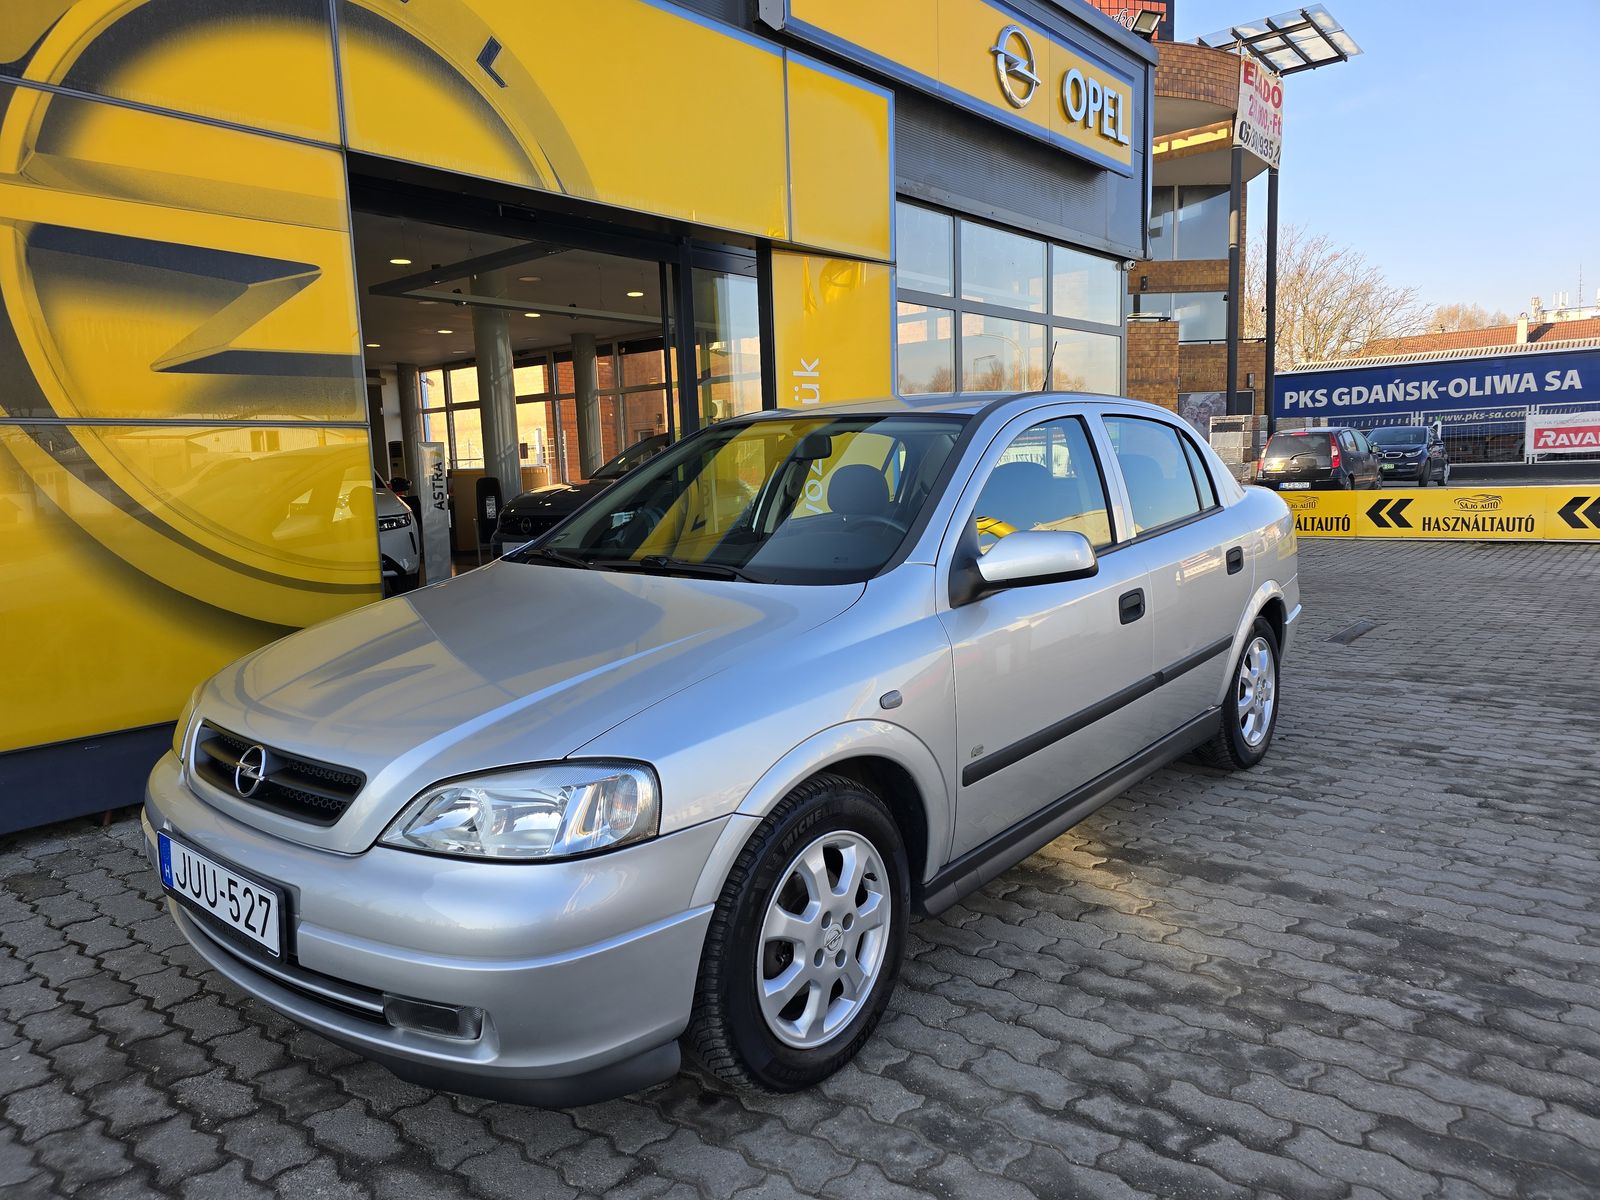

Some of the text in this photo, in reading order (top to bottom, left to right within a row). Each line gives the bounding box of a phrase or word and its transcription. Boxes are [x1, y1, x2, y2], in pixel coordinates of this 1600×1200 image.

[1063, 67, 1129, 146] OPEL
[1243, 60, 1282, 109] ELADÓ
[1284, 369, 1582, 410] PKS GDAŃSK-OLIWA SA
[1537, 430, 1600, 447] RAVA
[431, 461, 445, 511] ASTRA
[1295, 513, 1351, 532] ÁLTAUTÓ
[1422, 514, 1535, 533] HASZNÁLTAUTÓ
[175, 852, 271, 938] JUU-527
